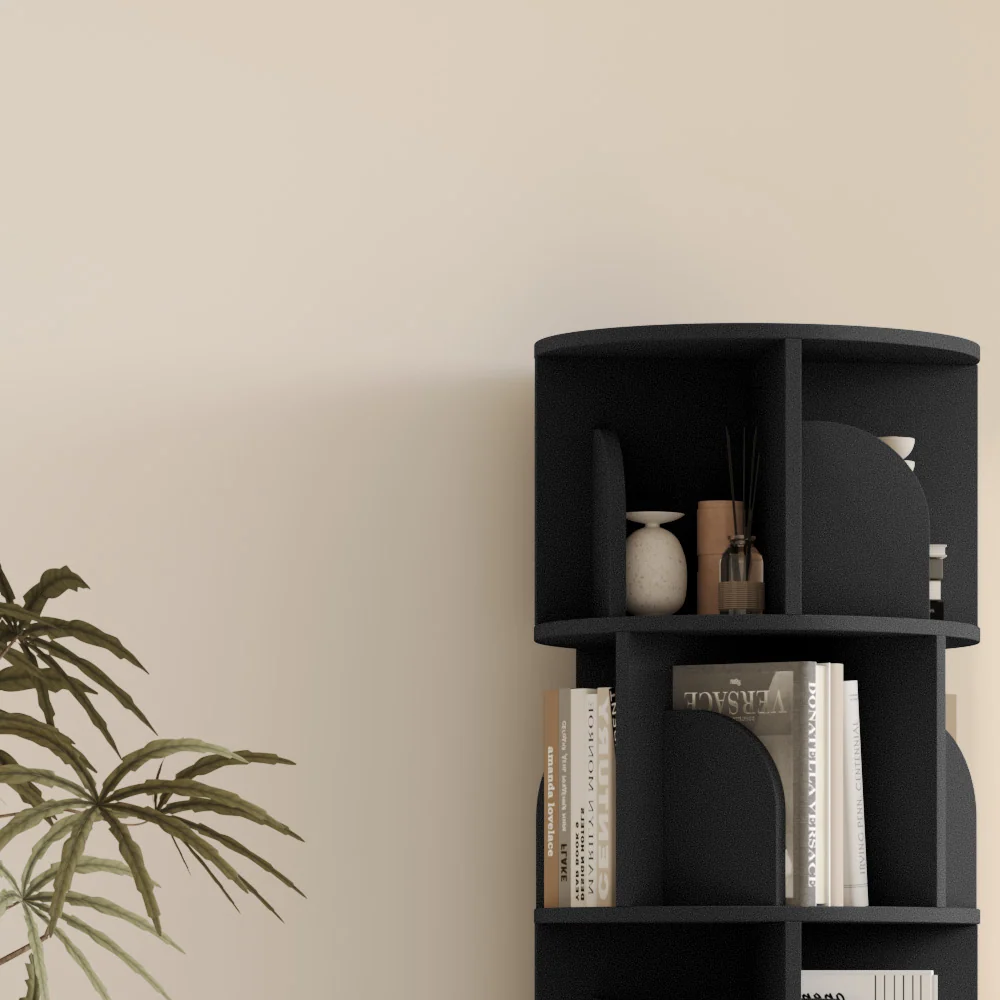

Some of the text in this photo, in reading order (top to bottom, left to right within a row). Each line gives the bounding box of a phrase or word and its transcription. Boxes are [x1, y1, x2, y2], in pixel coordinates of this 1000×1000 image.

[808, 682, 816, 888] DONATELLA VERSACE
[851, 721, 862, 792] CENTENNIAL
[857, 832, 867, 875] IRVING
